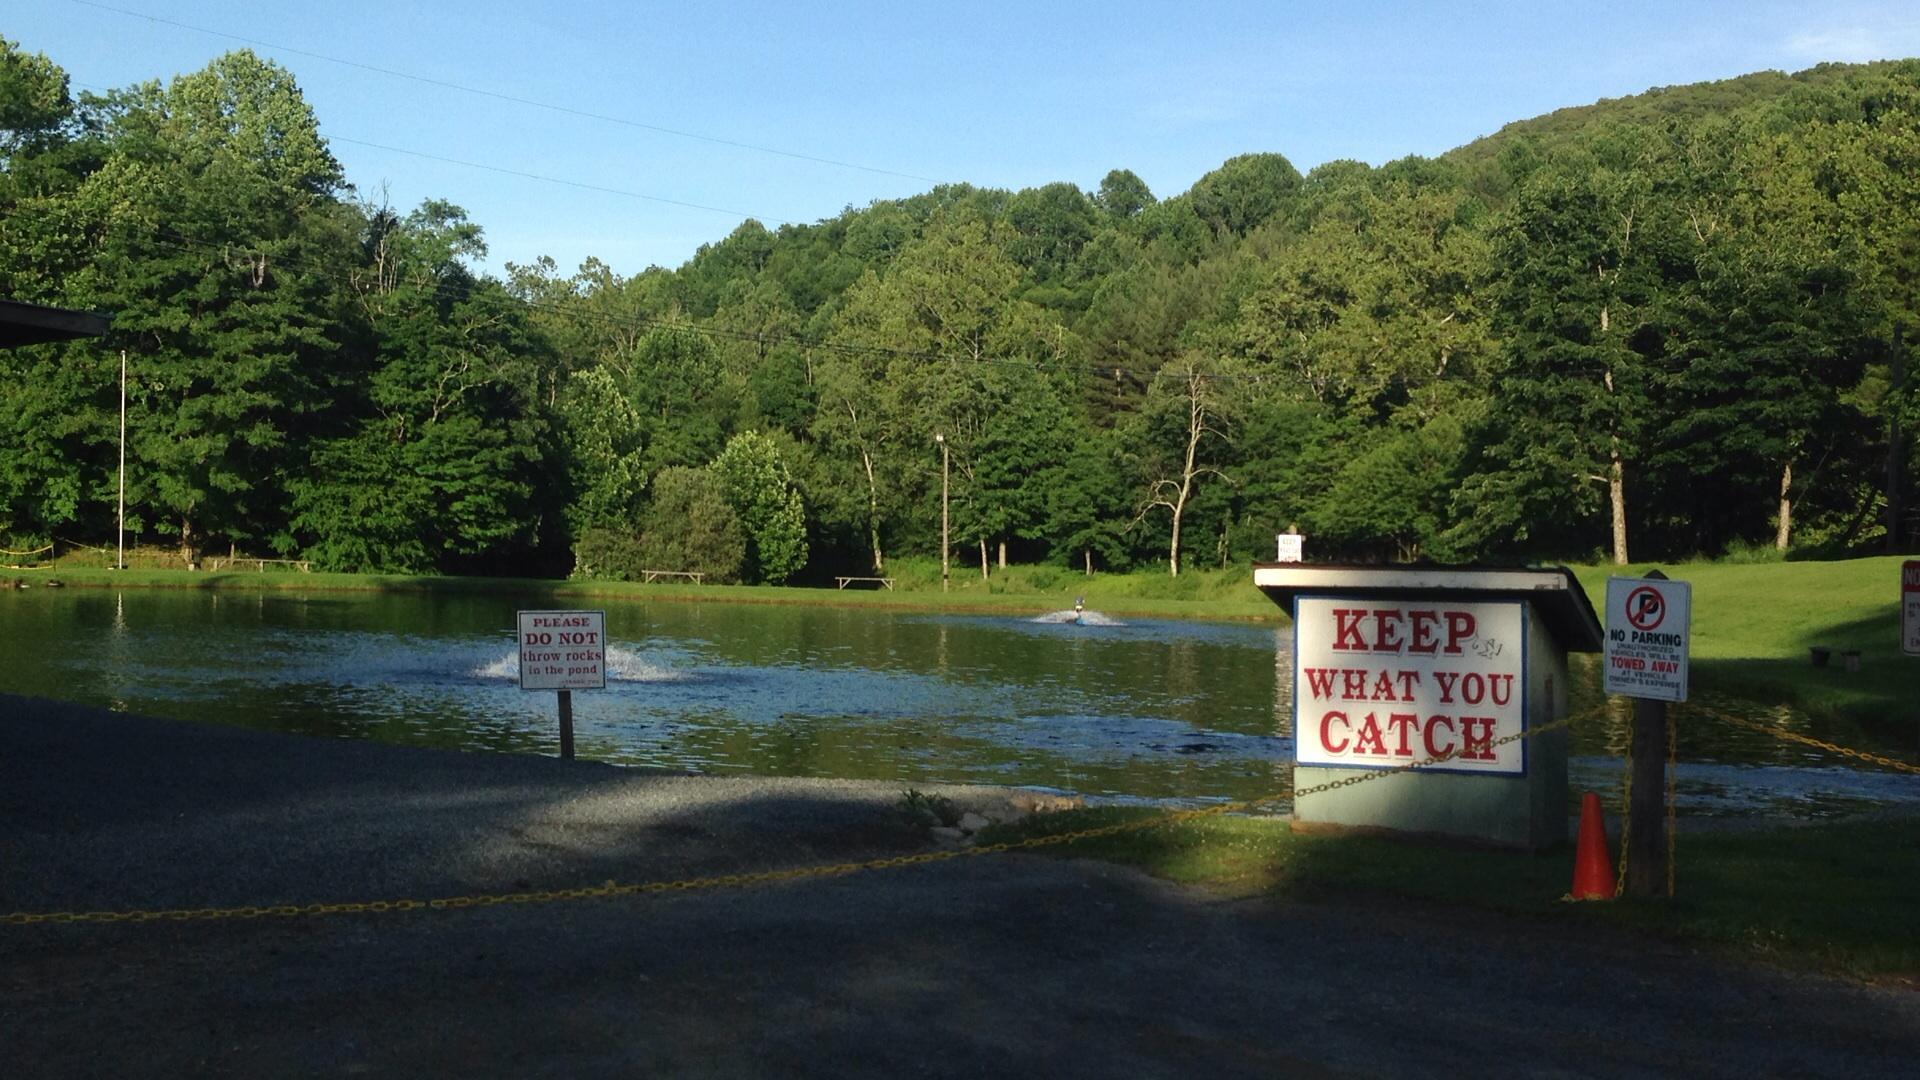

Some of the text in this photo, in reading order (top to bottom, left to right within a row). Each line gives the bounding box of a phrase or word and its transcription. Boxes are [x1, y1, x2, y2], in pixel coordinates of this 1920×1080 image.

[533, 617, 590, 627] PLEASE
[1332, 608, 1476, 654] KEEP
[525, 632, 598, 645] DO NOT
[1610, 629, 1682, 647] NO PARKING
[523, 649, 602, 662] throw rocks
[1610, 648, 1646, 658] VEHICLES
[1648, 652, 1668, 660] WILL
[528, 665, 597, 676] in the pond
[1610, 656, 1680, 674] TOWED AWAY
[1635, 671, 1667, 681] VEHICLE
[1304, 668, 1514, 706] WHAT YOU
[1320, 710, 1497, 761] CATCH
